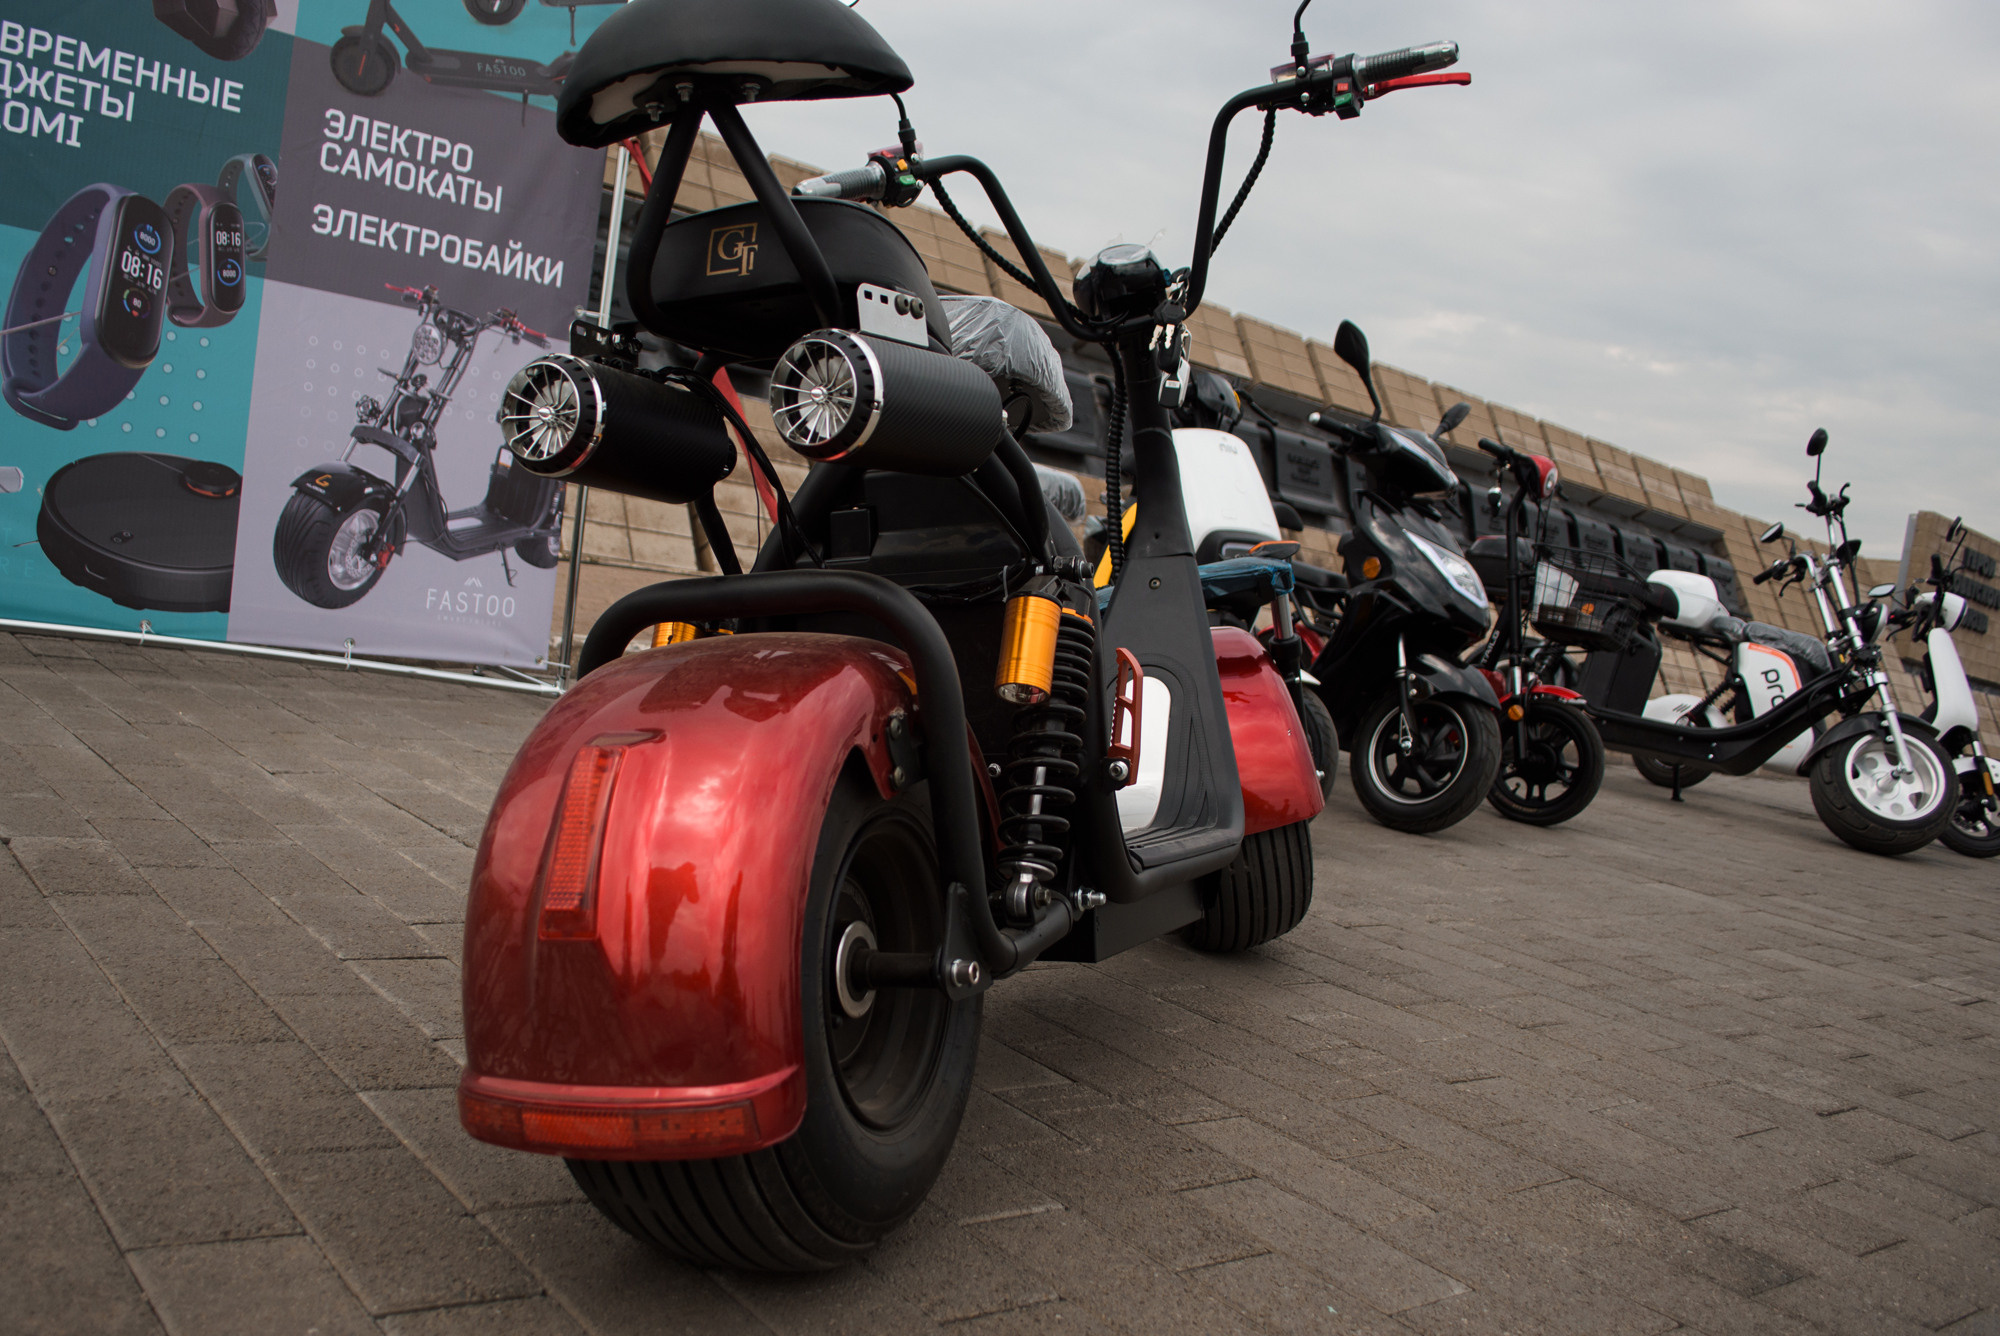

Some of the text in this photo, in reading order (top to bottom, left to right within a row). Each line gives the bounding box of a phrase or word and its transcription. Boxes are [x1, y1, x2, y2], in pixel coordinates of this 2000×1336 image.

[1, 20, 244, 113] ВРЕМЕННЫЕ
[476, 62, 527, 77] FASTOO
[0, 100, 84, 148] OMI
[323, 108, 474, 173] ЭЛЕКТРО
[320, 141, 503, 214] САМОКАТЫ
[214, 230, 241, 248] 08:16
[311, 203, 565, 288] ЭЛЕКТРОБАЙКИ
[121, 250, 164, 290] 08:16
[425, 588, 516, 618] FASTOO
